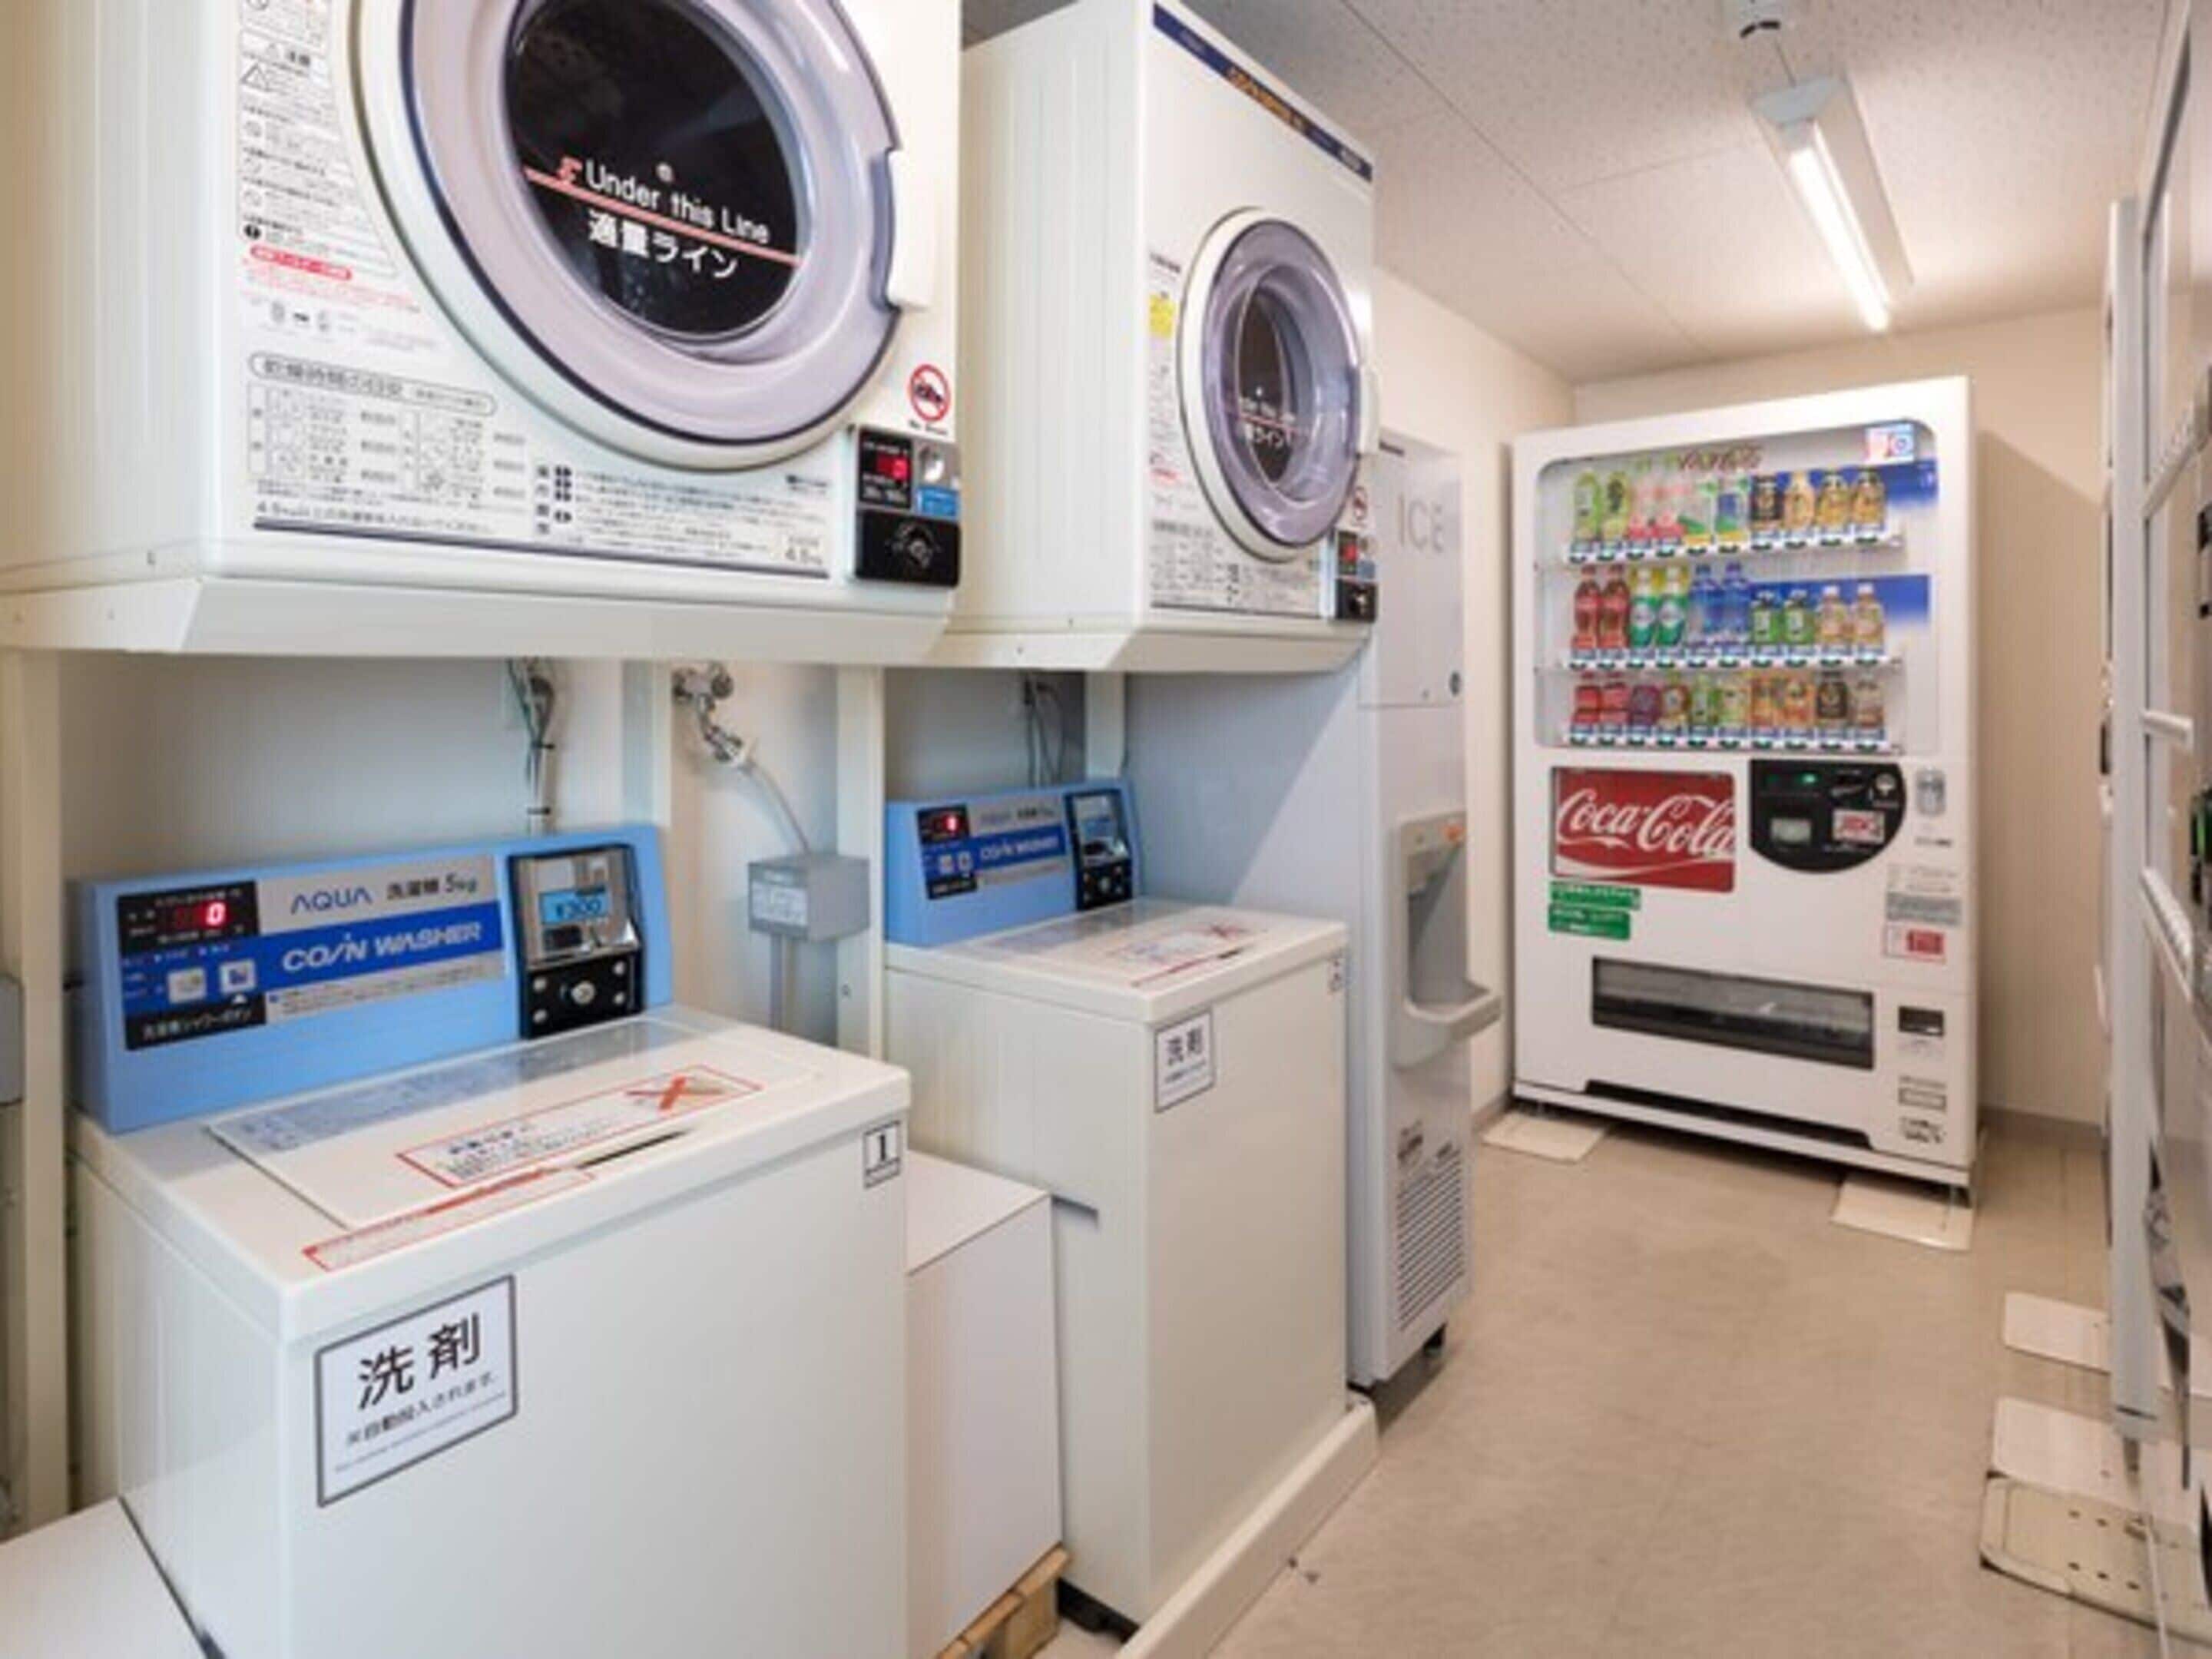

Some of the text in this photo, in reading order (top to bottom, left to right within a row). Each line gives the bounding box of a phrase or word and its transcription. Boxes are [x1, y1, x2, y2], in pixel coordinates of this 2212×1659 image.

[584, 158, 771, 244] Under this Line
[588, 208, 739, 280] 適量ライン
[1397, 492, 1444, 554] ICE
[1557, 788, 1735, 858] Coca-Cola
[206, 901, 227, 926] 0
[290, 886, 373, 915] AQUA
[375, 921, 483, 959] WASHER
[358, 1311, 482, 1412] 洗剤
